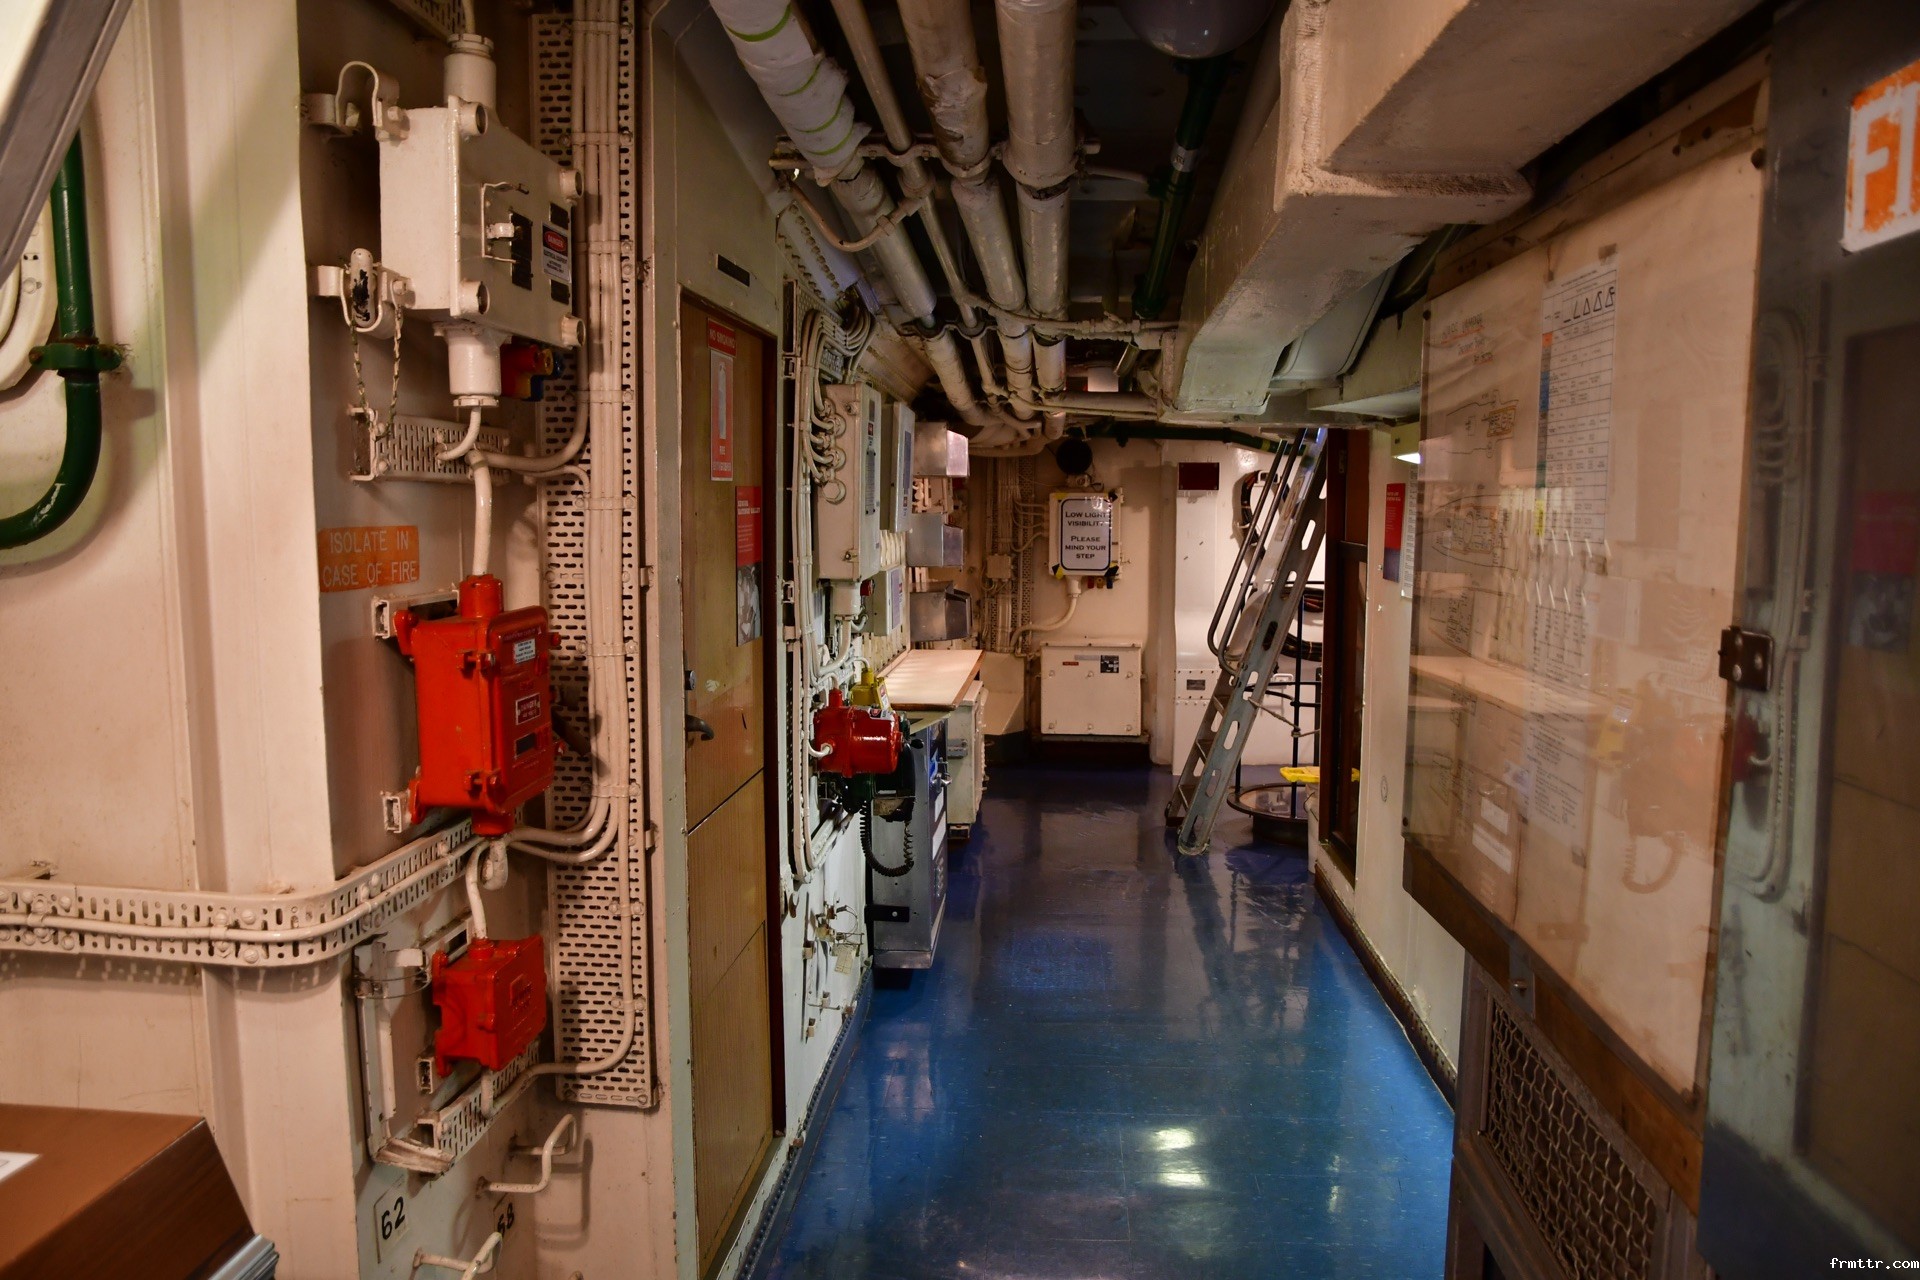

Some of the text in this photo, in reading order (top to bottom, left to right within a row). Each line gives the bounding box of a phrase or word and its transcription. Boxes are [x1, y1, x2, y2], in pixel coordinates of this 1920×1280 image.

[709, 329, 717, 341] NO
[329, 530, 409, 554] ISOLATE IN
[322, 560, 418, 588] CASE OF FIRE
[381, 1196, 406, 1241] 62
